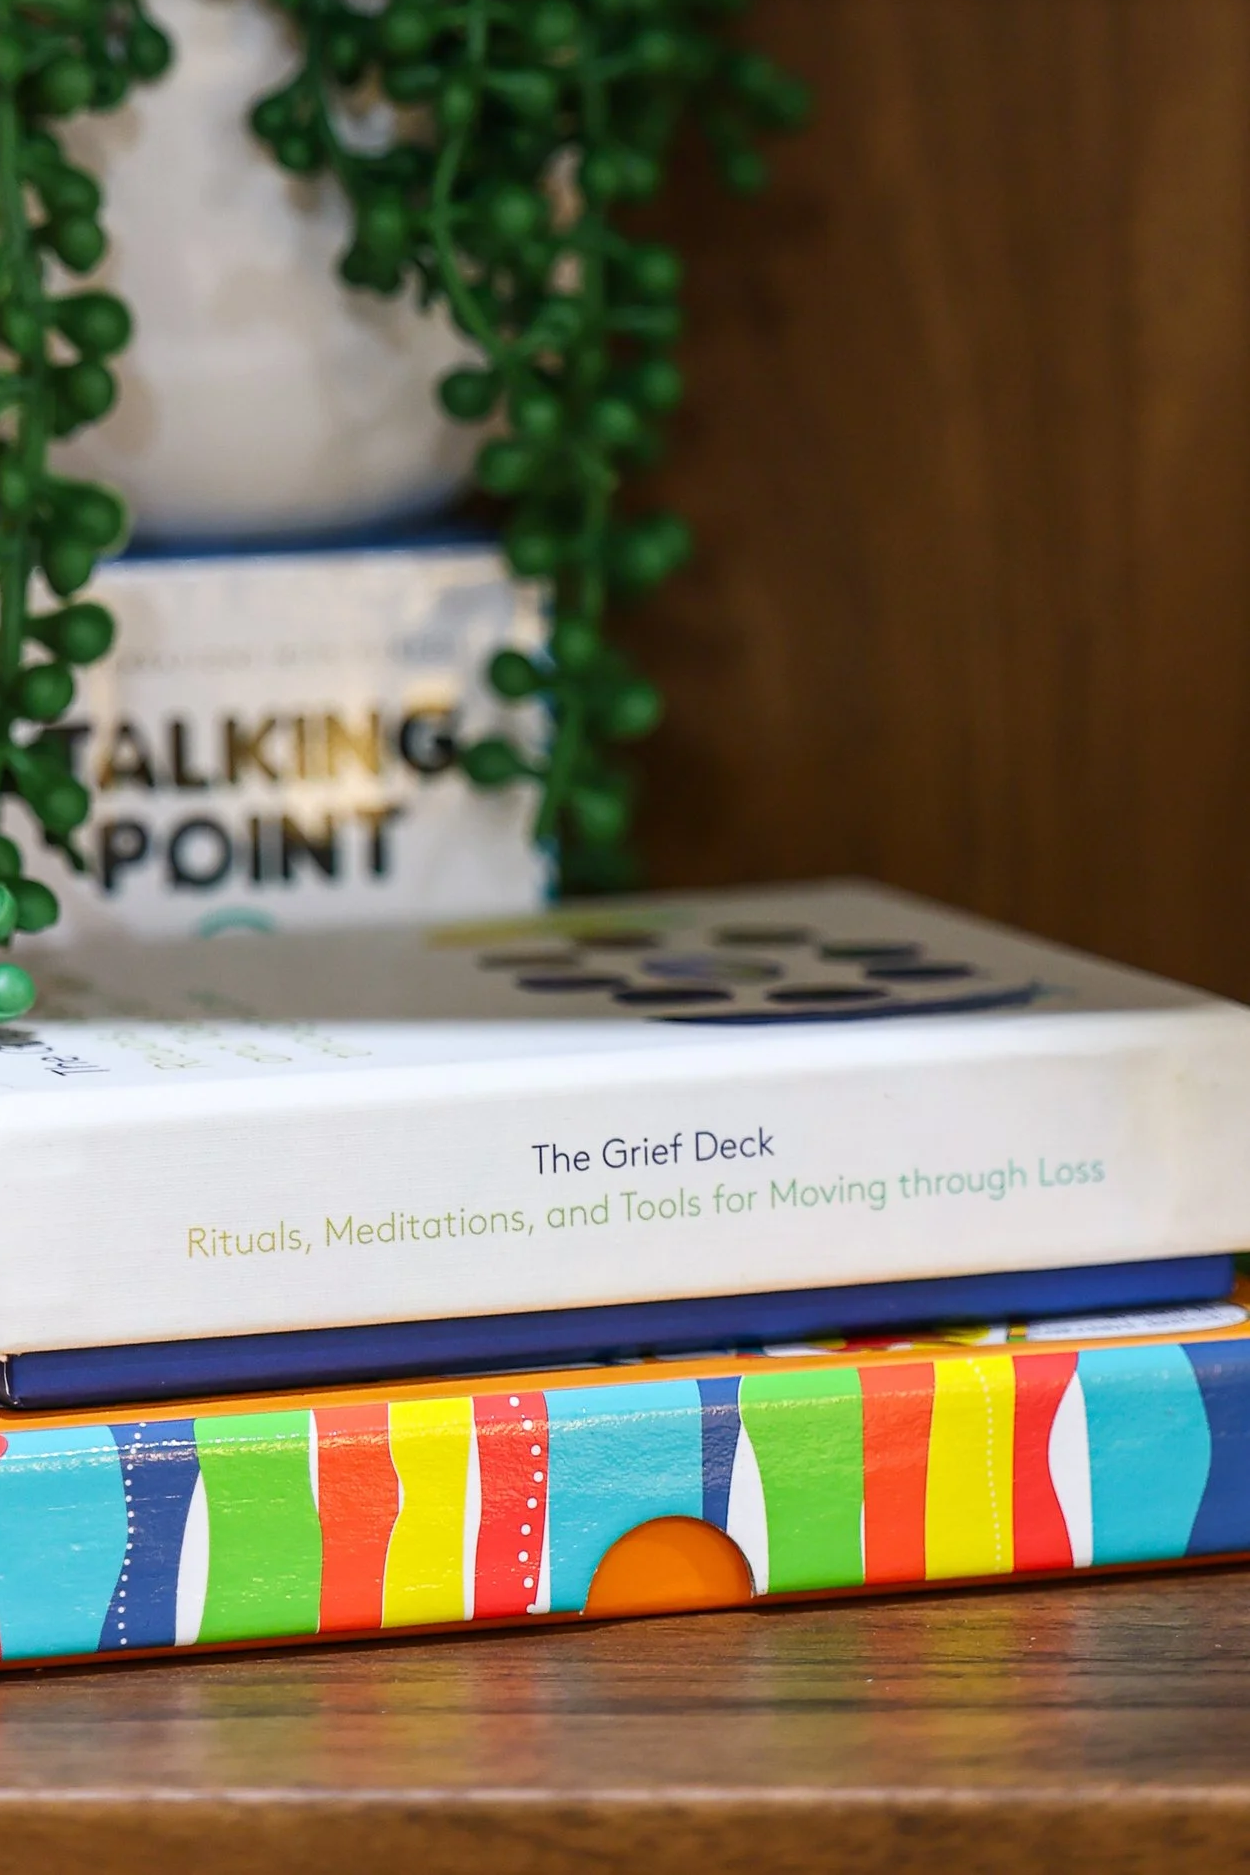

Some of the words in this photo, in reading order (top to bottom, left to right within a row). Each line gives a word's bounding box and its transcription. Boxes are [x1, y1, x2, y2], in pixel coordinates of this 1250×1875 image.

[100, 805, 405, 895] POINT
[532, 1143, 590, 1175] The
[602, 1135, 683, 1169] Grief
[694, 1127, 775, 1163] Deck
[188, 1220, 312, 1258] Rituals,
[324, 1205, 534, 1248] Meditations,
[547, 1195, 610, 1229] and
[621, 1185, 702, 1223] Tools
[712, 1183, 758, 1215] for
[770, 1176, 887, 1211] Moving
[898, 1158, 1027, 1201] through
[1038, 1156, 1105, 1187] Loss
